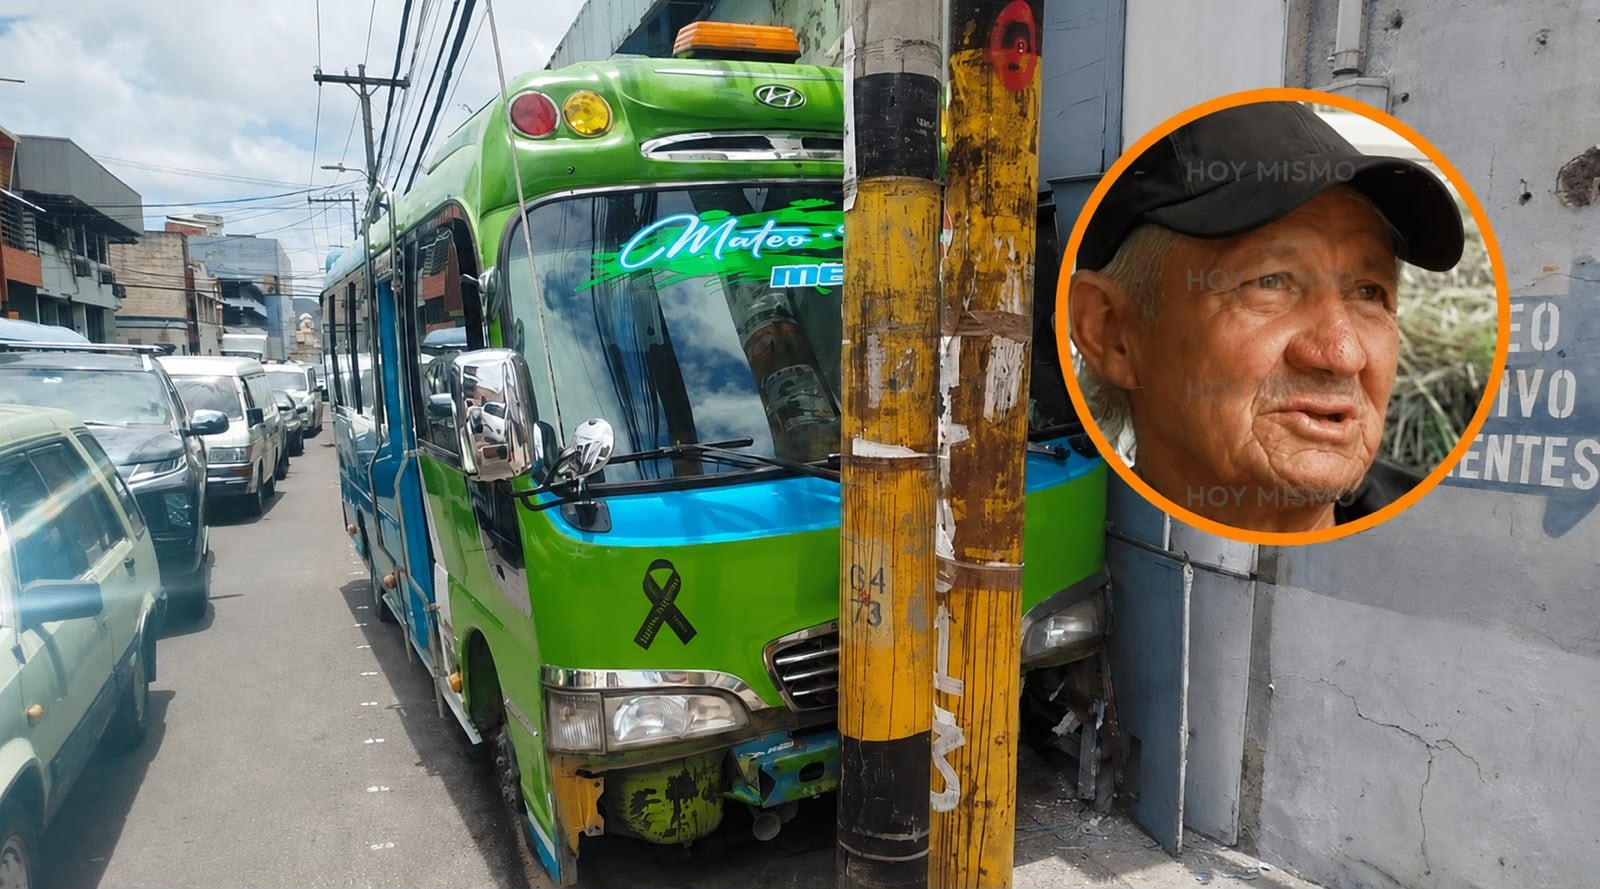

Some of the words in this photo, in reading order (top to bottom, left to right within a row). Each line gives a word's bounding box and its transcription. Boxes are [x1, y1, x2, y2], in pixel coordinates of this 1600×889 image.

[620, 214, 813, 269] Mateo
[1498, 368, 1576, 419] IVO
[1446, 433, 1600, 491] ENTES
